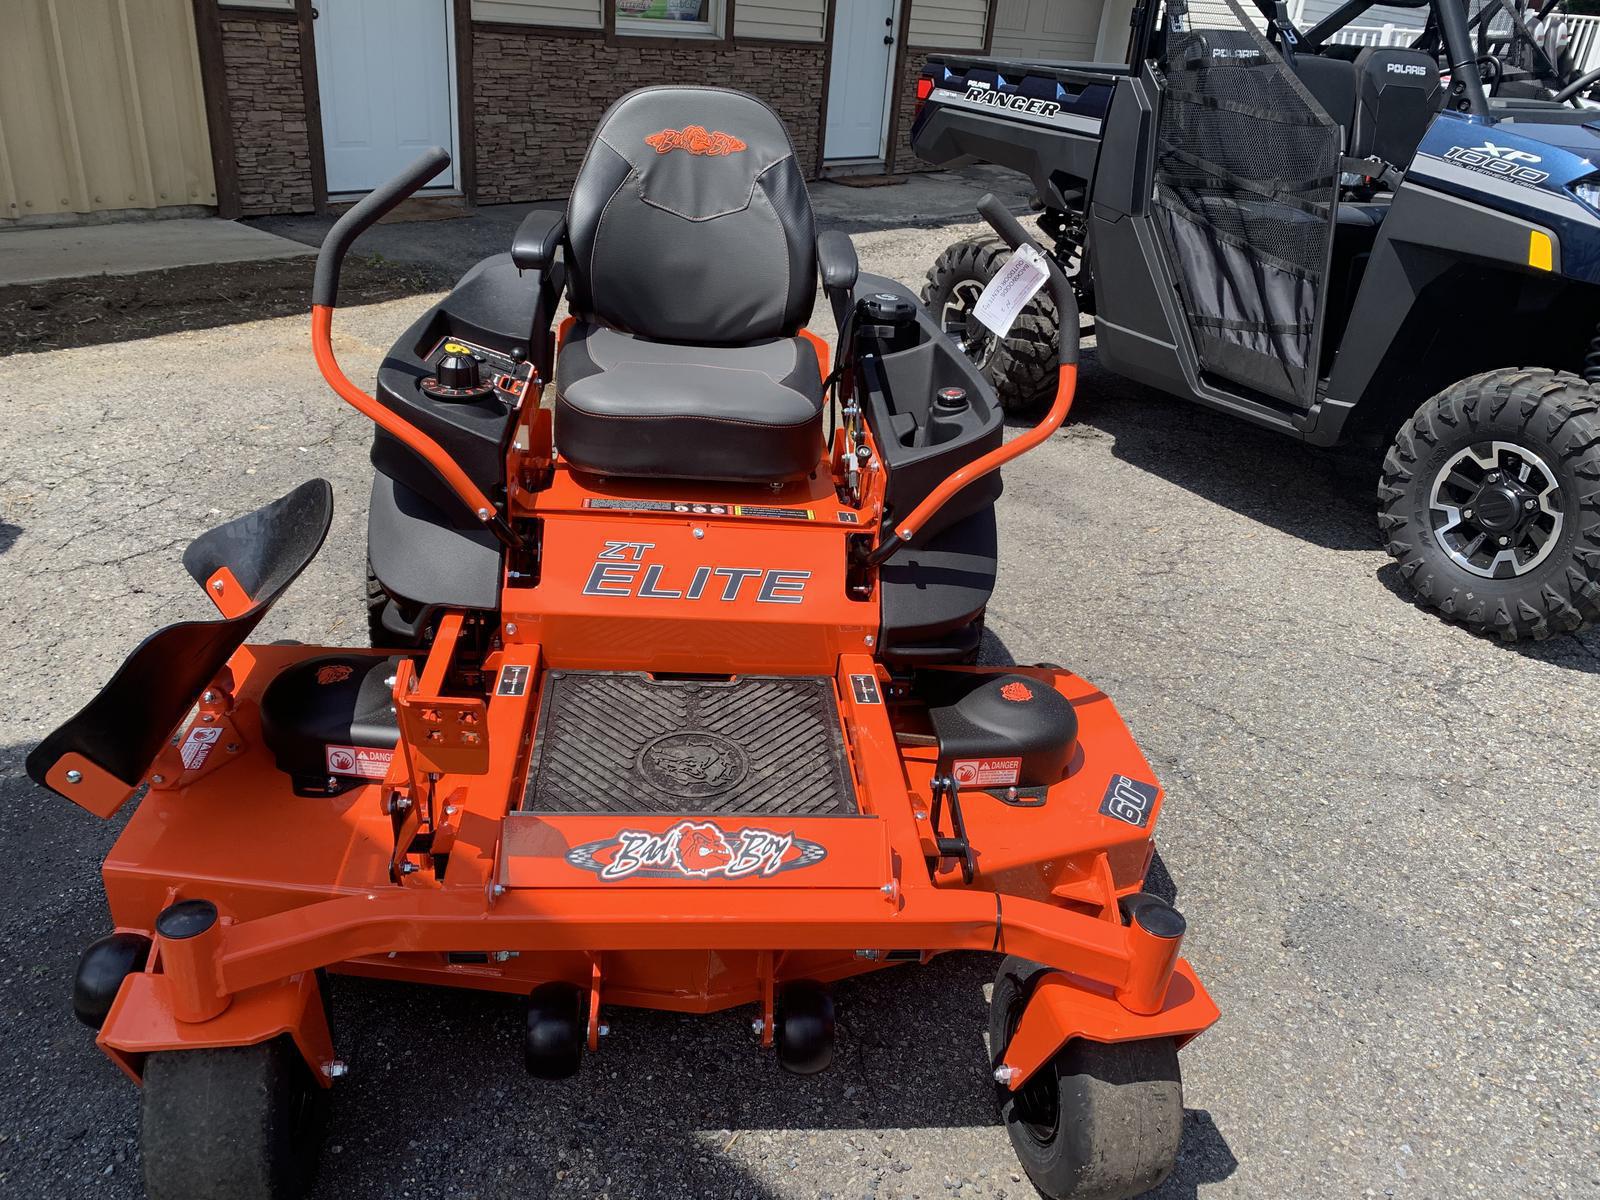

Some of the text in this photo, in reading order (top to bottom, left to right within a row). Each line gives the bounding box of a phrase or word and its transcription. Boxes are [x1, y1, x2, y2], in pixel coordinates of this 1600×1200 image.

[1387, 63, 1426, 76] POLARIS
[967, 80, 991, 90] POLARIS
[964, 87, 1061, 118] RANGER
[1470, 141, 1542, 163] XP
[1443, 146, 1550, 184] 1000
[1002, 258, 1025, 286] OUTDOOR
[597, 541, 656, 561] ZT
[581, 561, 813, 604] ELITE
[369, 752, 394, 762] DANG
[991, 761, 1019, 770] DANGER
[601, 829, 792, 878] Bad Boy
